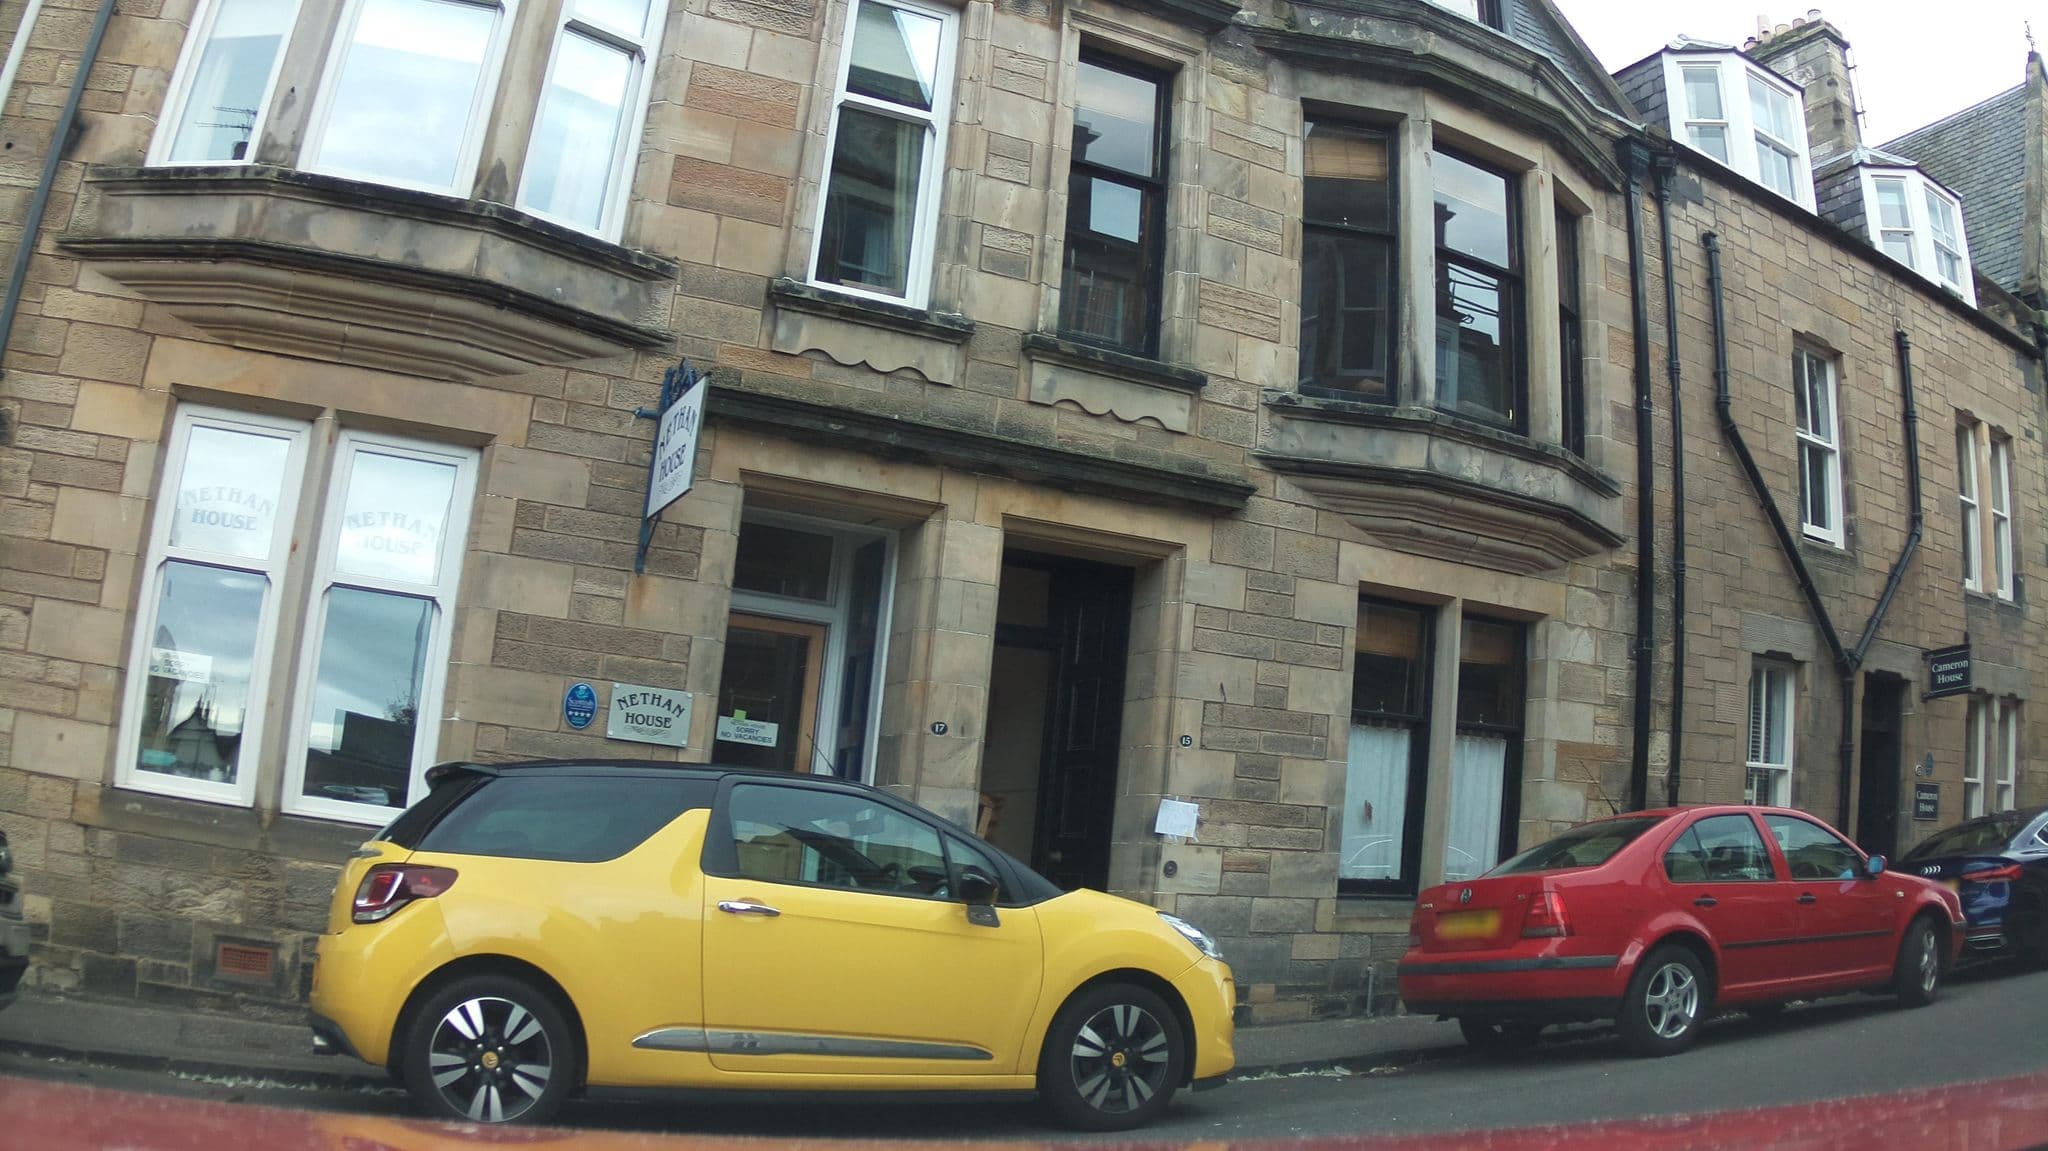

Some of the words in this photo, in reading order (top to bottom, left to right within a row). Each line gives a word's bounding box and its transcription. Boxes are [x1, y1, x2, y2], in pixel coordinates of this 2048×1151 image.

[659, 406, 697, 461] NETHAN
[659, 444, 686, 482] HOUSE
[183, 486, 275, 515] NETHAN
[191, 507, 257, 531] HOUSE
[347, 511, 438, 540] NETHAN
[1932, 659, 1968, 673] Cameron
[1937, 673, 1963, 684] House
[617, 692, 685, 718] NETHAN
[625, 712, 672, 728] HOUSE
[935, 723, 945, 733] 17
[734, 732, 772, 743] VACANCIES
[736, 726, 760, 735] SORRY
[1182, 736, 1191, 745] 15
